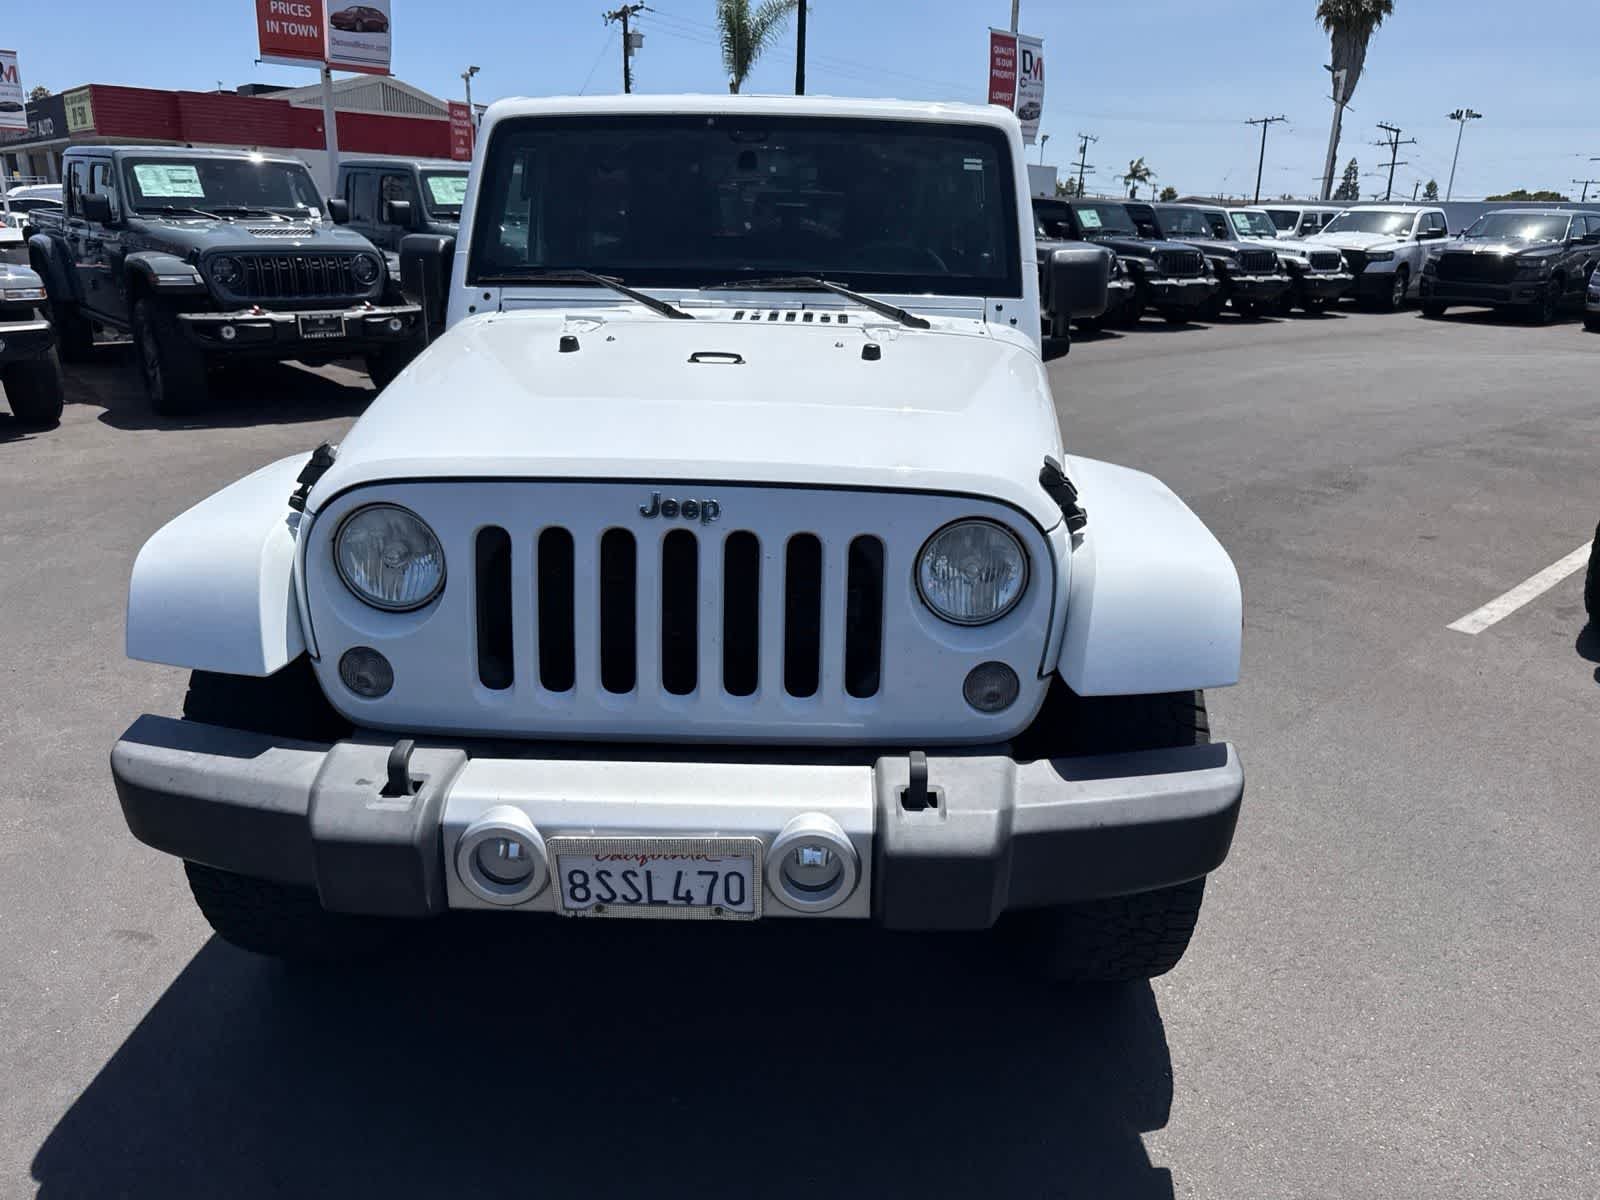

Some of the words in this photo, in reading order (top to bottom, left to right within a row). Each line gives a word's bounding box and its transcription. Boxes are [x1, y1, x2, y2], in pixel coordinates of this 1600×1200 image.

[269, 0, 312, 18] PRICES
[266, 20, 279, 33] IN
[281, 22, 318, 38] TOWN
[993, 46, 1015, 57] QUALITY
[996, 57, 1001, 65] IS
[1001, 58, 1013, 67] OUR
[992, 69, 1015, 80] PRIORITY
[992, 91, 1013, 102] LOWEST
[38, 118, 54, 136] AUTO
[639, 490, 721, 526] Jeep
[567, 868, 745, 906] 8SSL470
